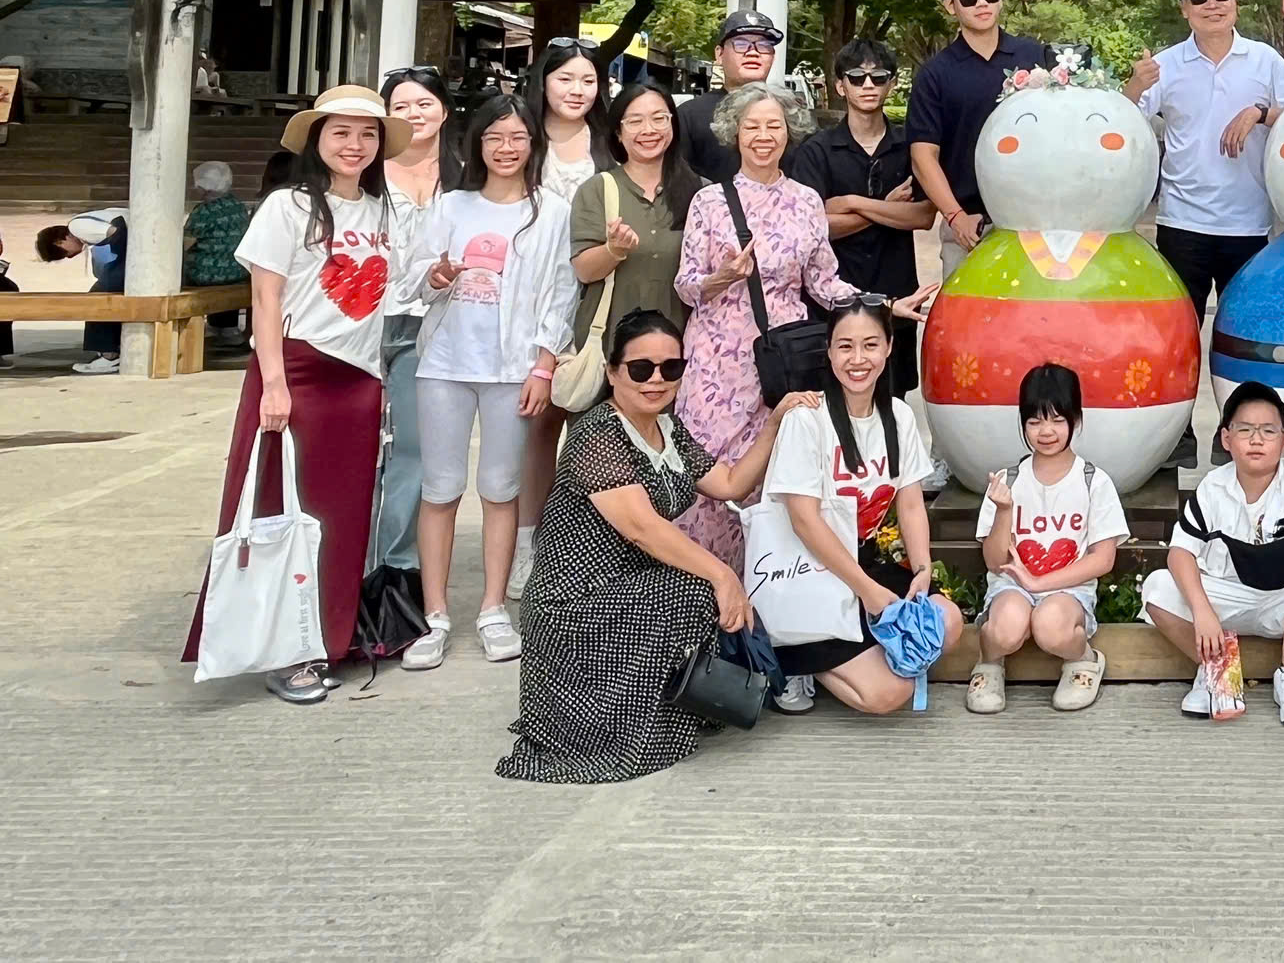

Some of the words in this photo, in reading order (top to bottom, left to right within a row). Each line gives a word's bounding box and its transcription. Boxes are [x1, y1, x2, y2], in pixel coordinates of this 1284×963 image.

[833, 445, 886, 481] Lov
[1016, 505, 1083, 535] Love
[748, 552, 812, 600] Smile
